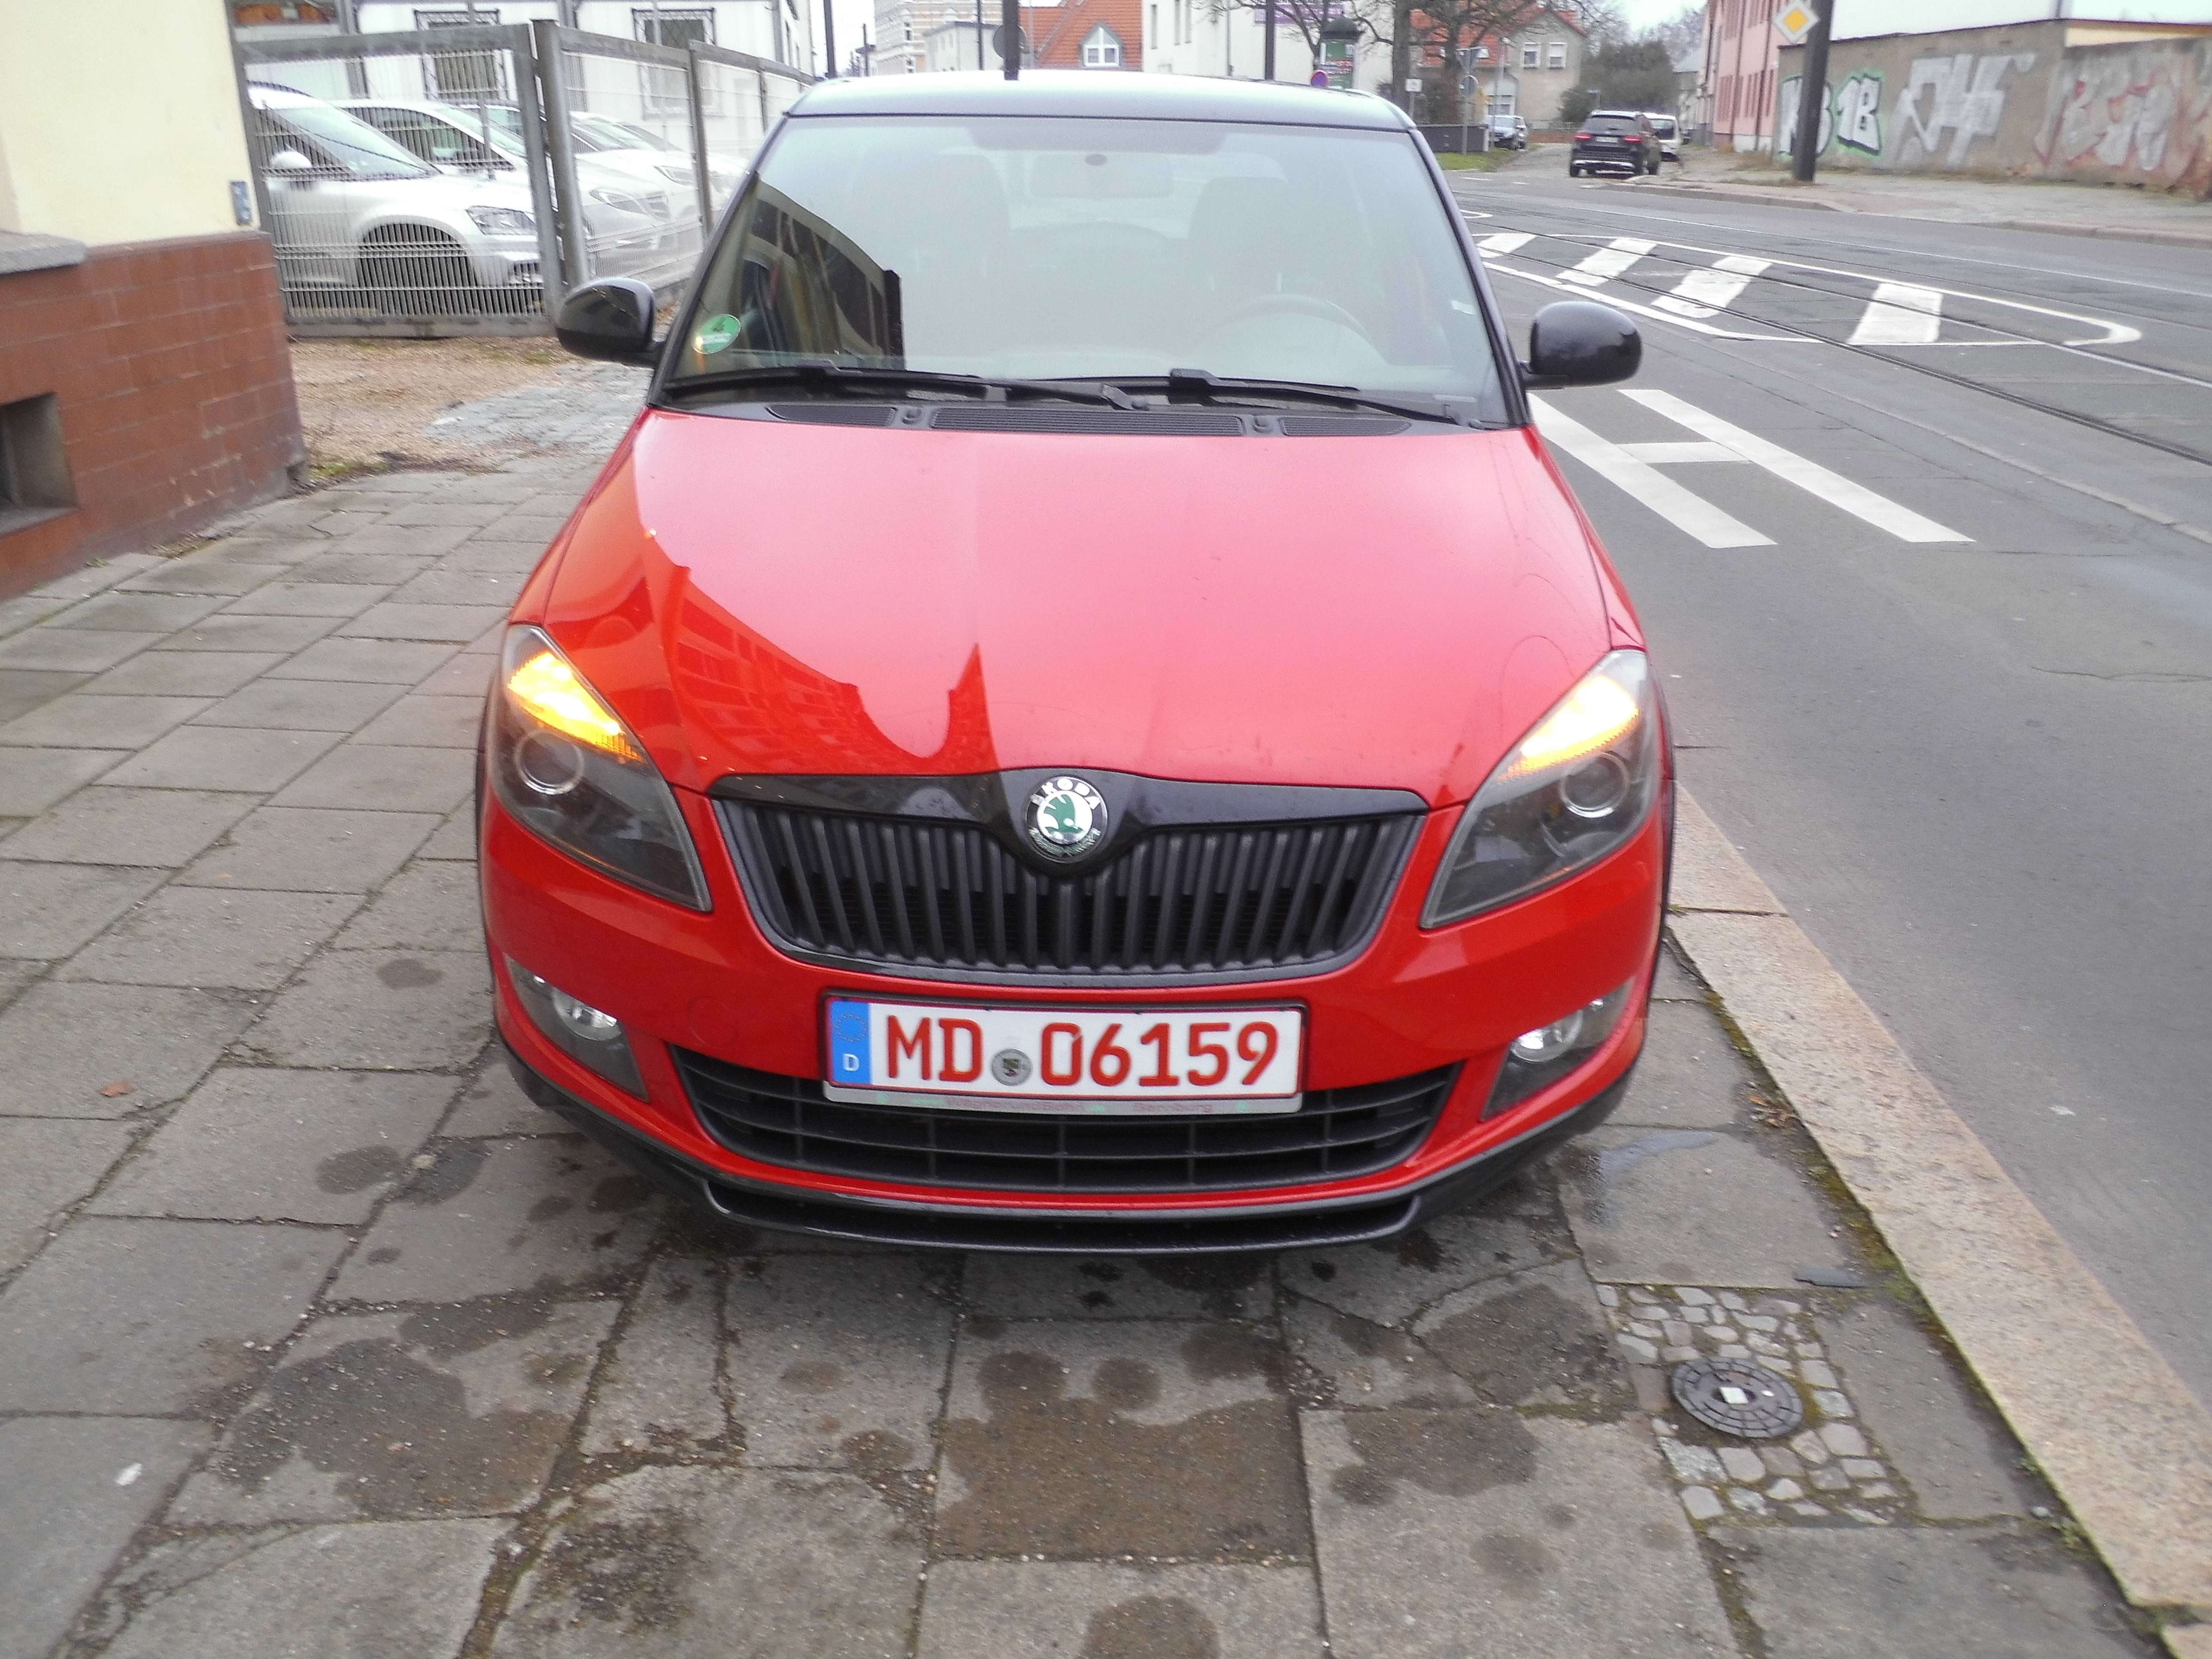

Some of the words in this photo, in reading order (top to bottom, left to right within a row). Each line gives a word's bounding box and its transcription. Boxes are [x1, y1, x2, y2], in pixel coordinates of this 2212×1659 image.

[842, 1053, 860, 1072] D
[887, 1015, 983, 1082] MD
[1041, 1022, 1279, 1087] 06159
